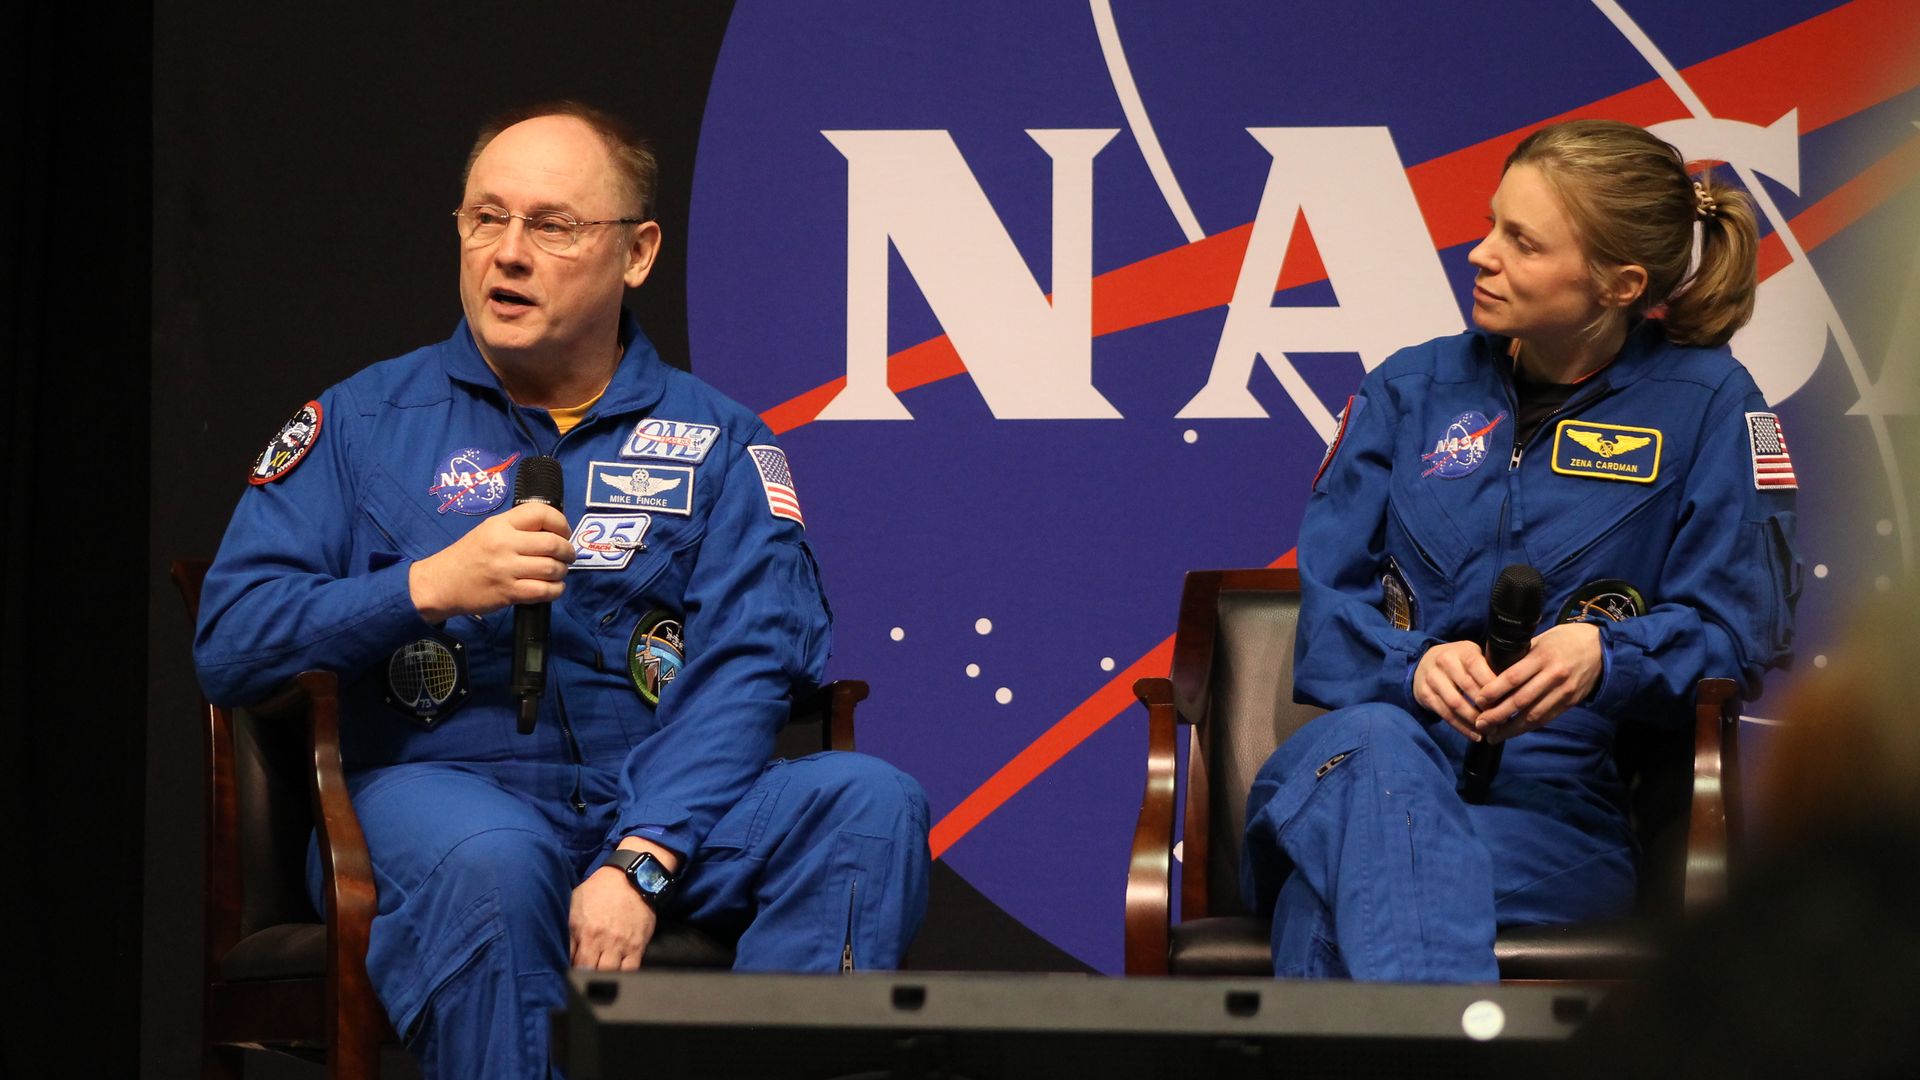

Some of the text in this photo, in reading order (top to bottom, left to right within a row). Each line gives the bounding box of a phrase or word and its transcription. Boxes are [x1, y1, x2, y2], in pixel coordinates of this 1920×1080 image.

[814, 106, 1920, 421] NAS
[631, 421, 715, 460] ONE
[1435, 435, 1486, 453] NASA
[1569, 458, 1638, 473] ZENA CARDMAN
[440, 471, 507, 487] NASA
[609, 495, 668, 506] MIKE FINCKE
[575, 521, 636, 562] 25
[588, 542, 612, 551] MACH
[419, 698, 432, 709] 73
